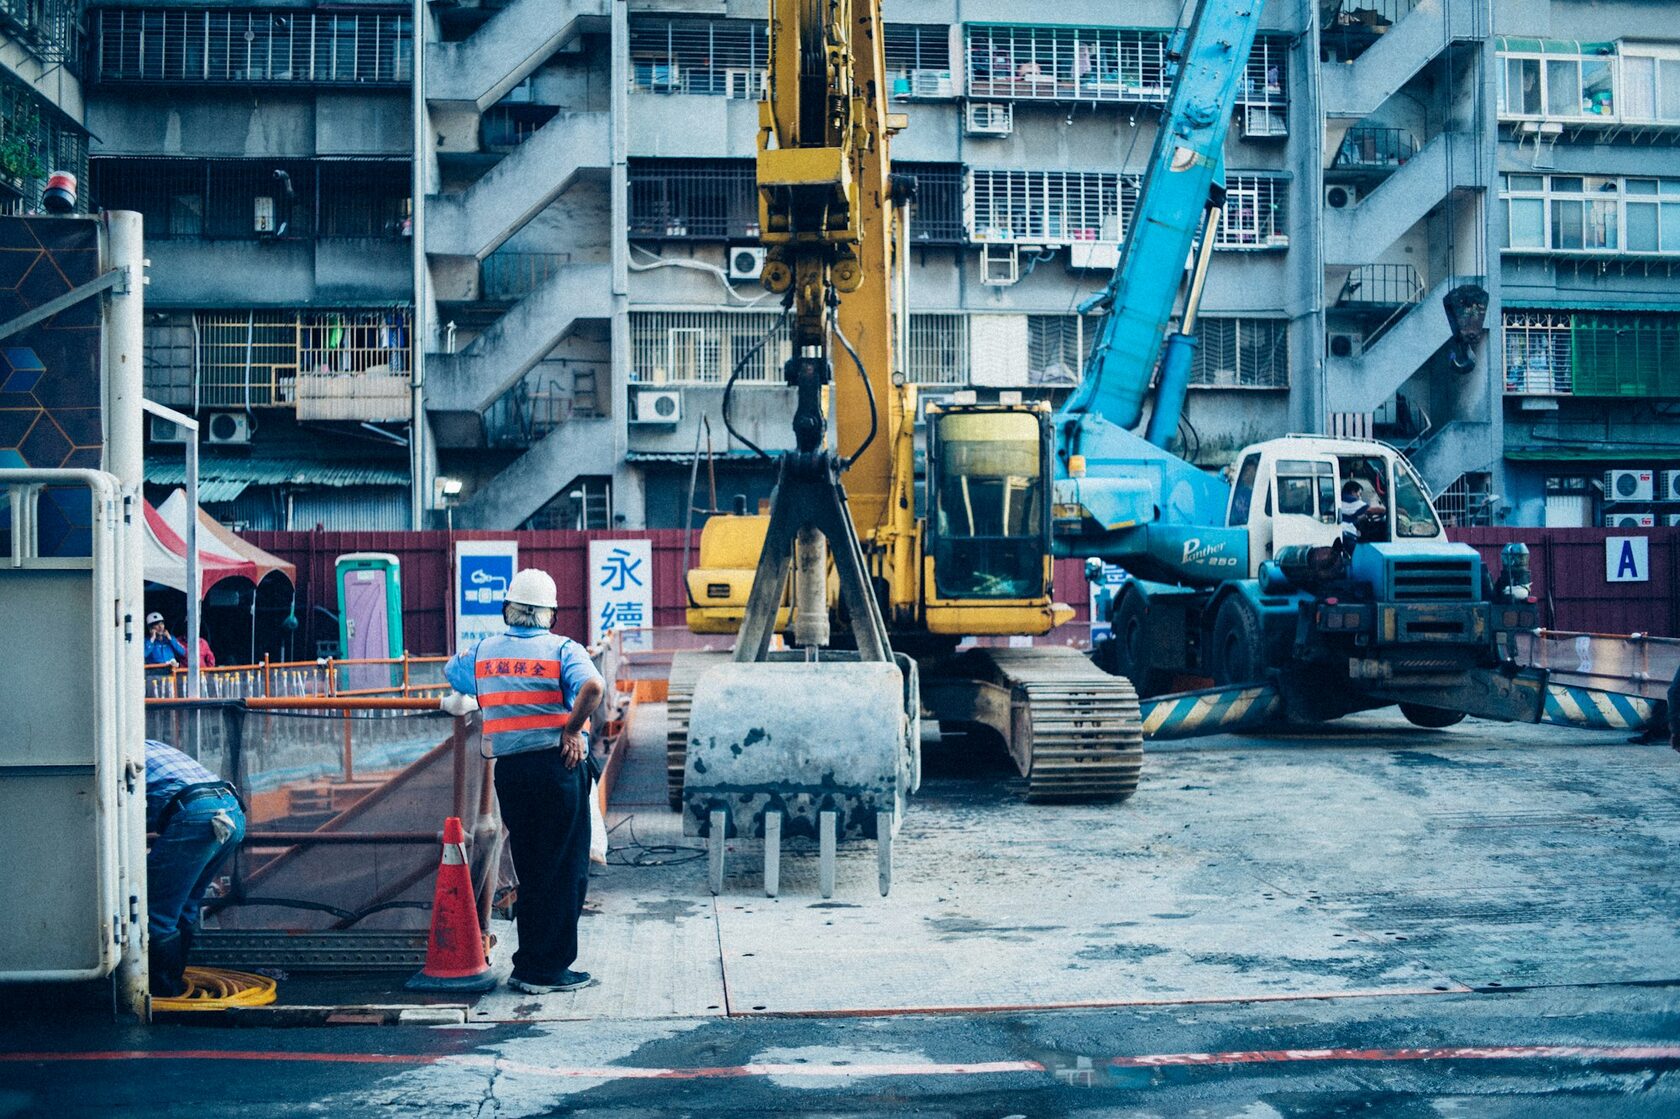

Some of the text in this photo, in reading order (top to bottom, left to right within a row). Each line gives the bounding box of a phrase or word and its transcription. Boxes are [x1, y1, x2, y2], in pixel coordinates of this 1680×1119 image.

[1181, 538, 1226, 564] Panther
[1617, 540, 1638, 578] A
[600, 548, 643, 644] 永續
